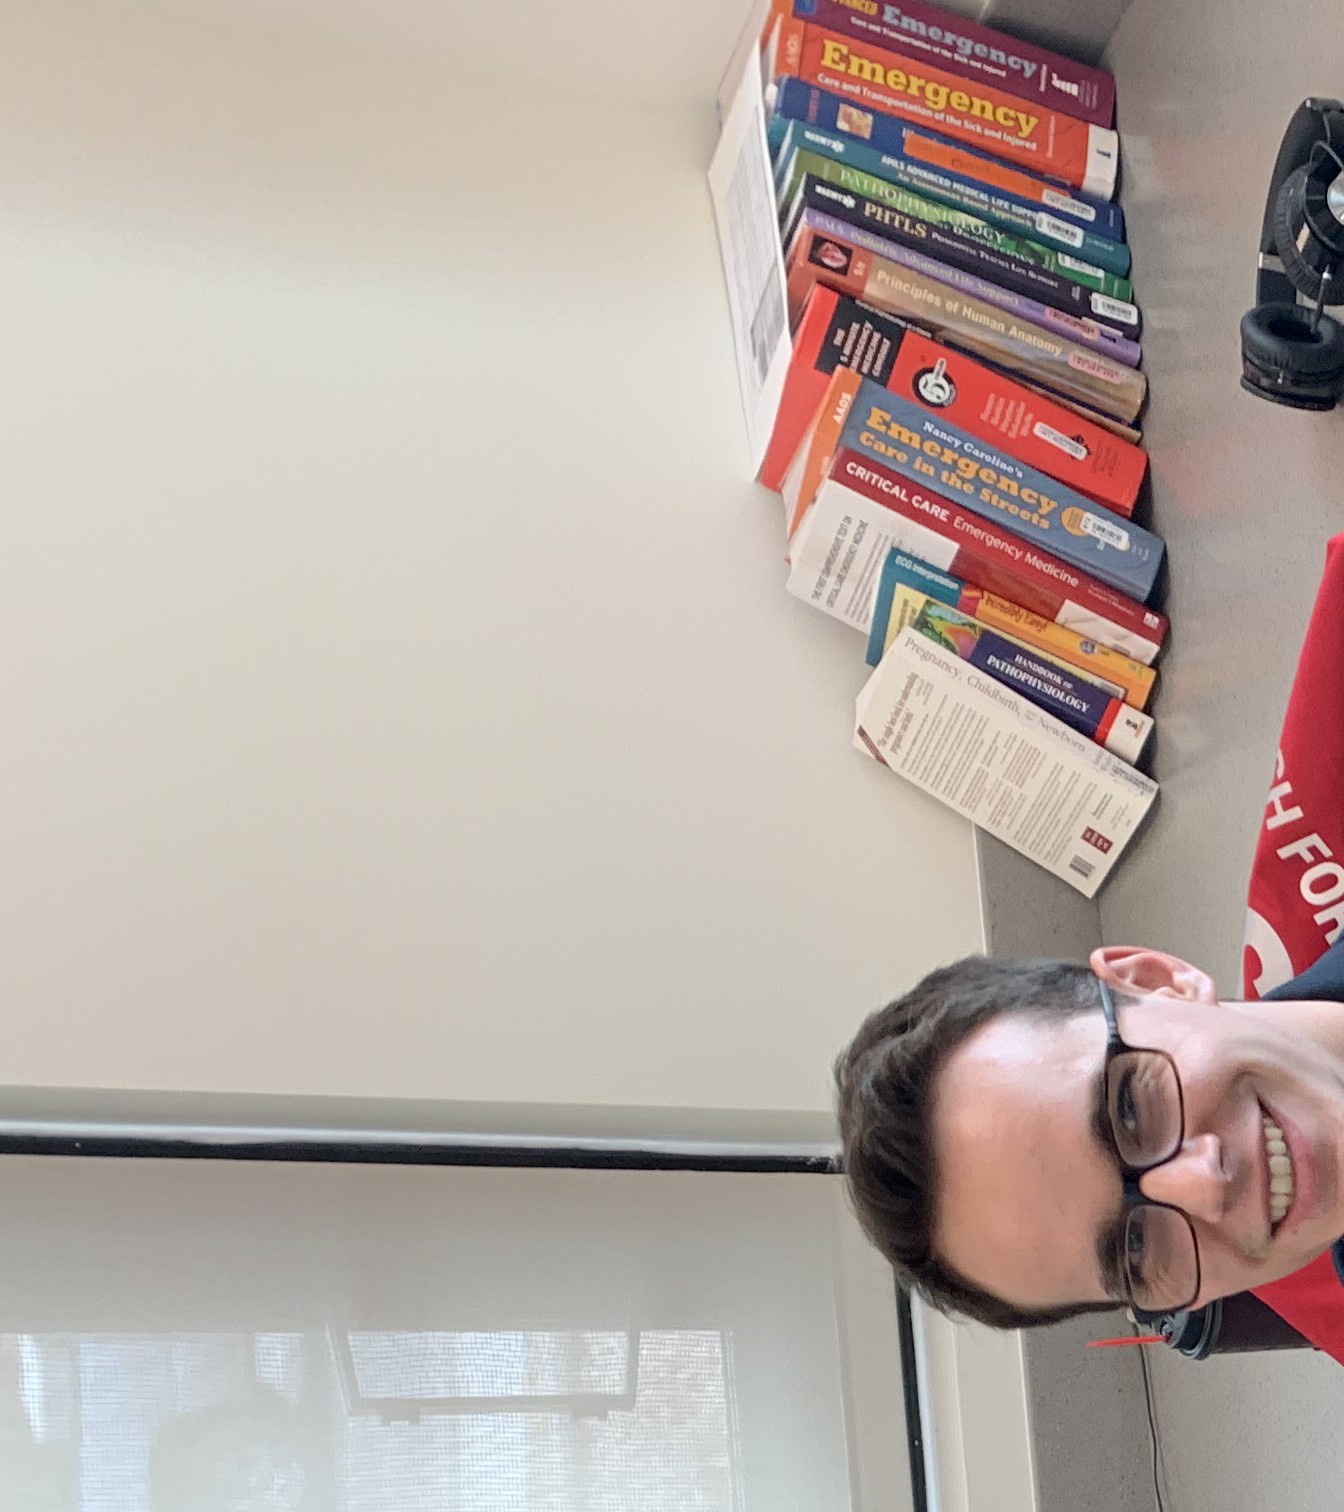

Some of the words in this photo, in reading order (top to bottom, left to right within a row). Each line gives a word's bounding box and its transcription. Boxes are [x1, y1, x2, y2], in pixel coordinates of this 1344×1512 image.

[850, 16, 868, 28] Care
[882, 26, 933, 53] Transportation
[882, 3, 1037, 78] Emergency
[817, 72, 838, 91] Care
[840, 79, 860, 96] and
[861, 84, 934, 121] Transportation
[934, 110, 945, 124] of
[946, 113, 962, 129] the
[963, 118, 983, 136] Sick
[984, 124, 1001, 141] and
[1003, 128, 1037, 151] Injured
[820, 38, 1039, 137] Emergency
[840, 168, 1006, 243] PATHOPHYSIOLOGY
[905, 165, 951, 190] ADVANCED
[952, 180, 991, 203] MEDICAL
[992, 194, 1010, 209] LIFE
[863, 202, 928, 240] PHTLS
[902, 248, 953, 277] Advanced
[977, 279, 1020, 306] Support
[876, 270, 943, 308] Principles
[945, 293, 960, 312] of
[961, 302, 1006, 335] Human
[1007, 322, 1063, 358] Anatomy
[832, 392, 852, 425] AAOS
[864, 406, 1059, 513] Emergency
[922, 419, 963, 449] Nancy
[963, 440, 1024, 479] Caroline's
[858, 430, 909, 465] Care
[913, 458, 936, 479] in
[940, 469, 976, 495] the
[980, 483, 1051, 531] Streets
[845, 461, 910, 503] CRITICAL
[911, 494, 950, 524] CARE
[952, 516, 1024, 563] Emergency
[1024, 550, 1080, 590] Medicine
[895, 555, 911, 570] ECG
[904, 636, 962, 680] Pregnancy,
[966, 674, 1022, 716] Childbirth,
[986, 654, 1091, 714] PATHOPHYSIOLOGY
[1014, 652, 1064, 686] HANDBOOK
[1038, 712, 1086, 753] Newborn
